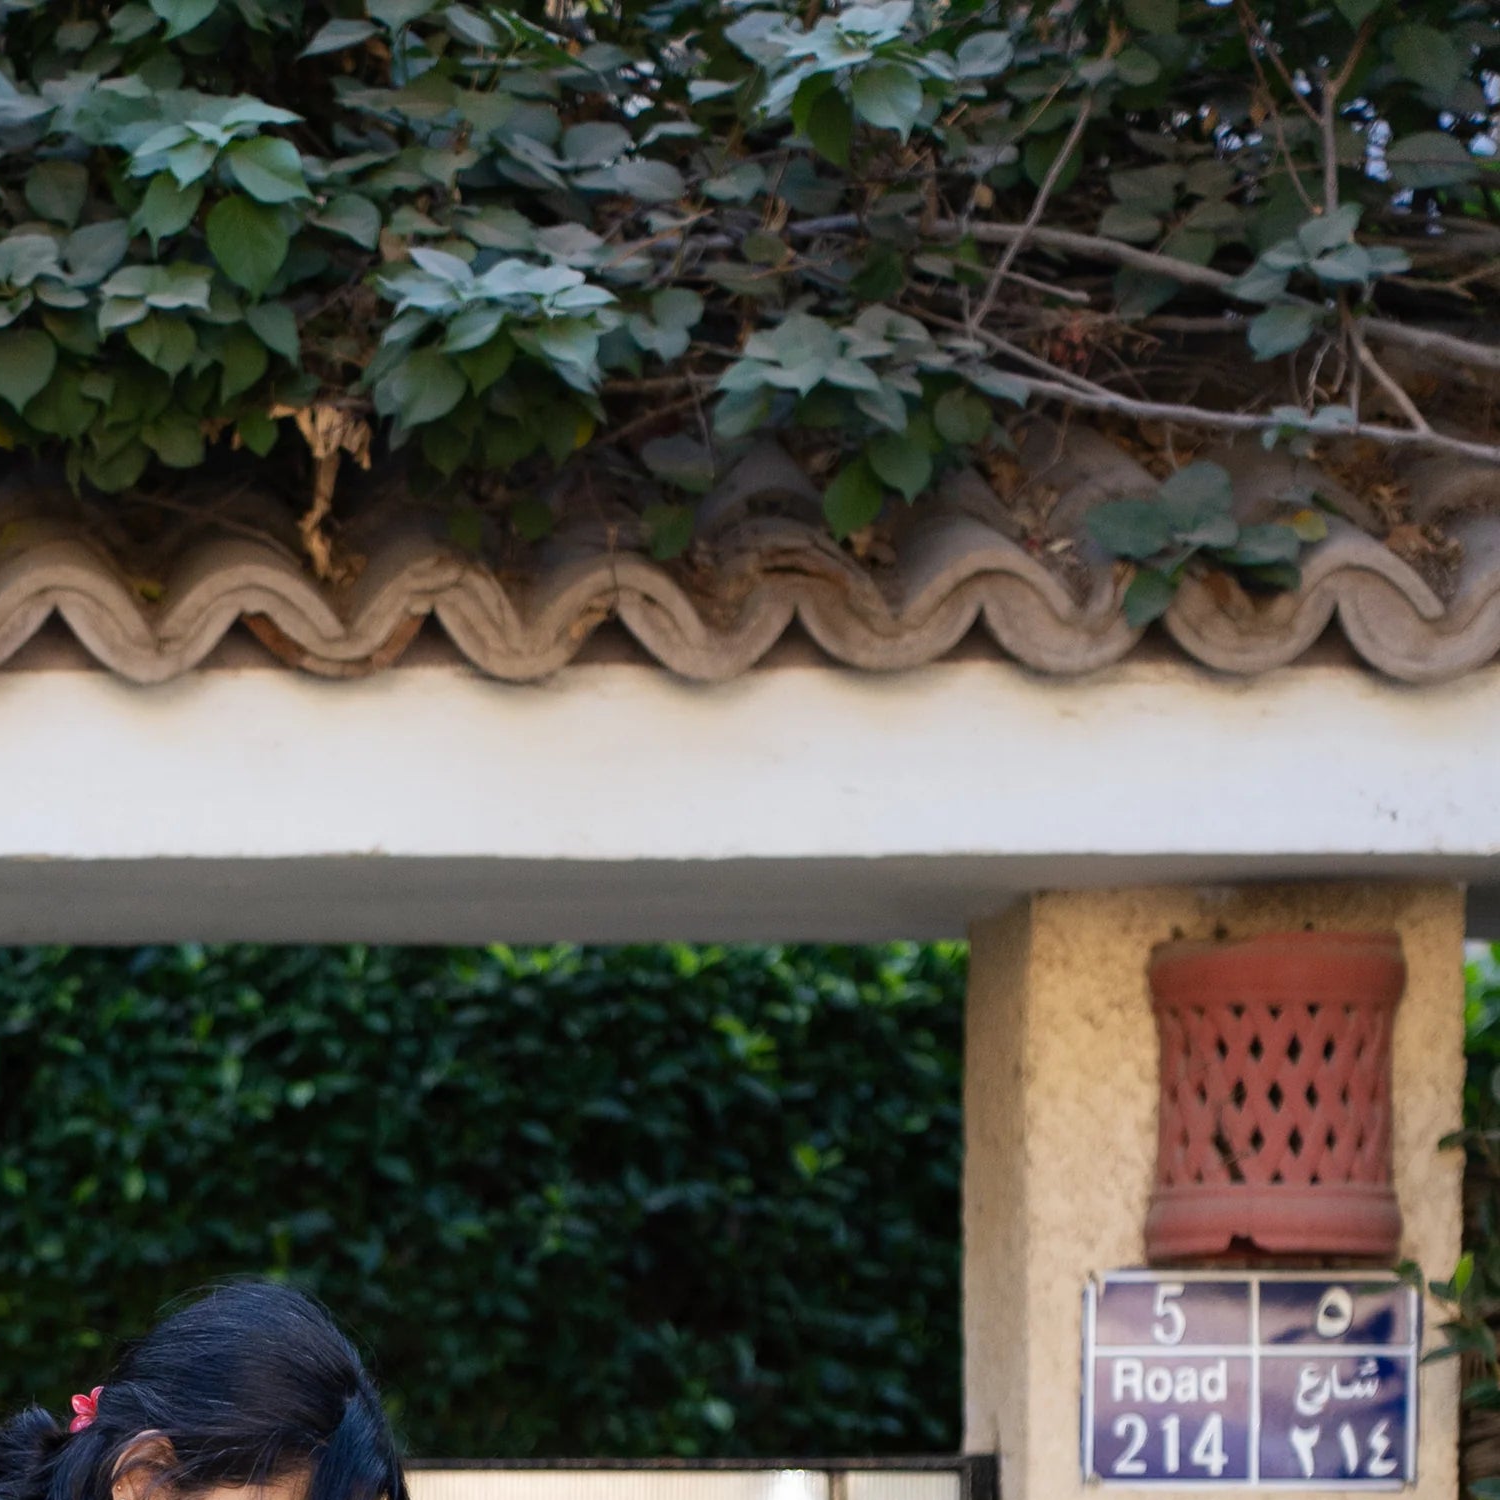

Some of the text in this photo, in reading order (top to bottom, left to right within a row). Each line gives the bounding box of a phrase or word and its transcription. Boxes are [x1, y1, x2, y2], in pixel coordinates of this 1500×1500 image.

[1153, 1283, 1187, 1345] 5
[1316, 1286, 1354, 1338] ٥
[1113, 1358, 1228, 1403] Road
[1296, 1356, 1380, 1416] شارع
[1113, 1412, 1229, 1477] 214
[1290, 1419, 1399, 1479] ٢١٤
